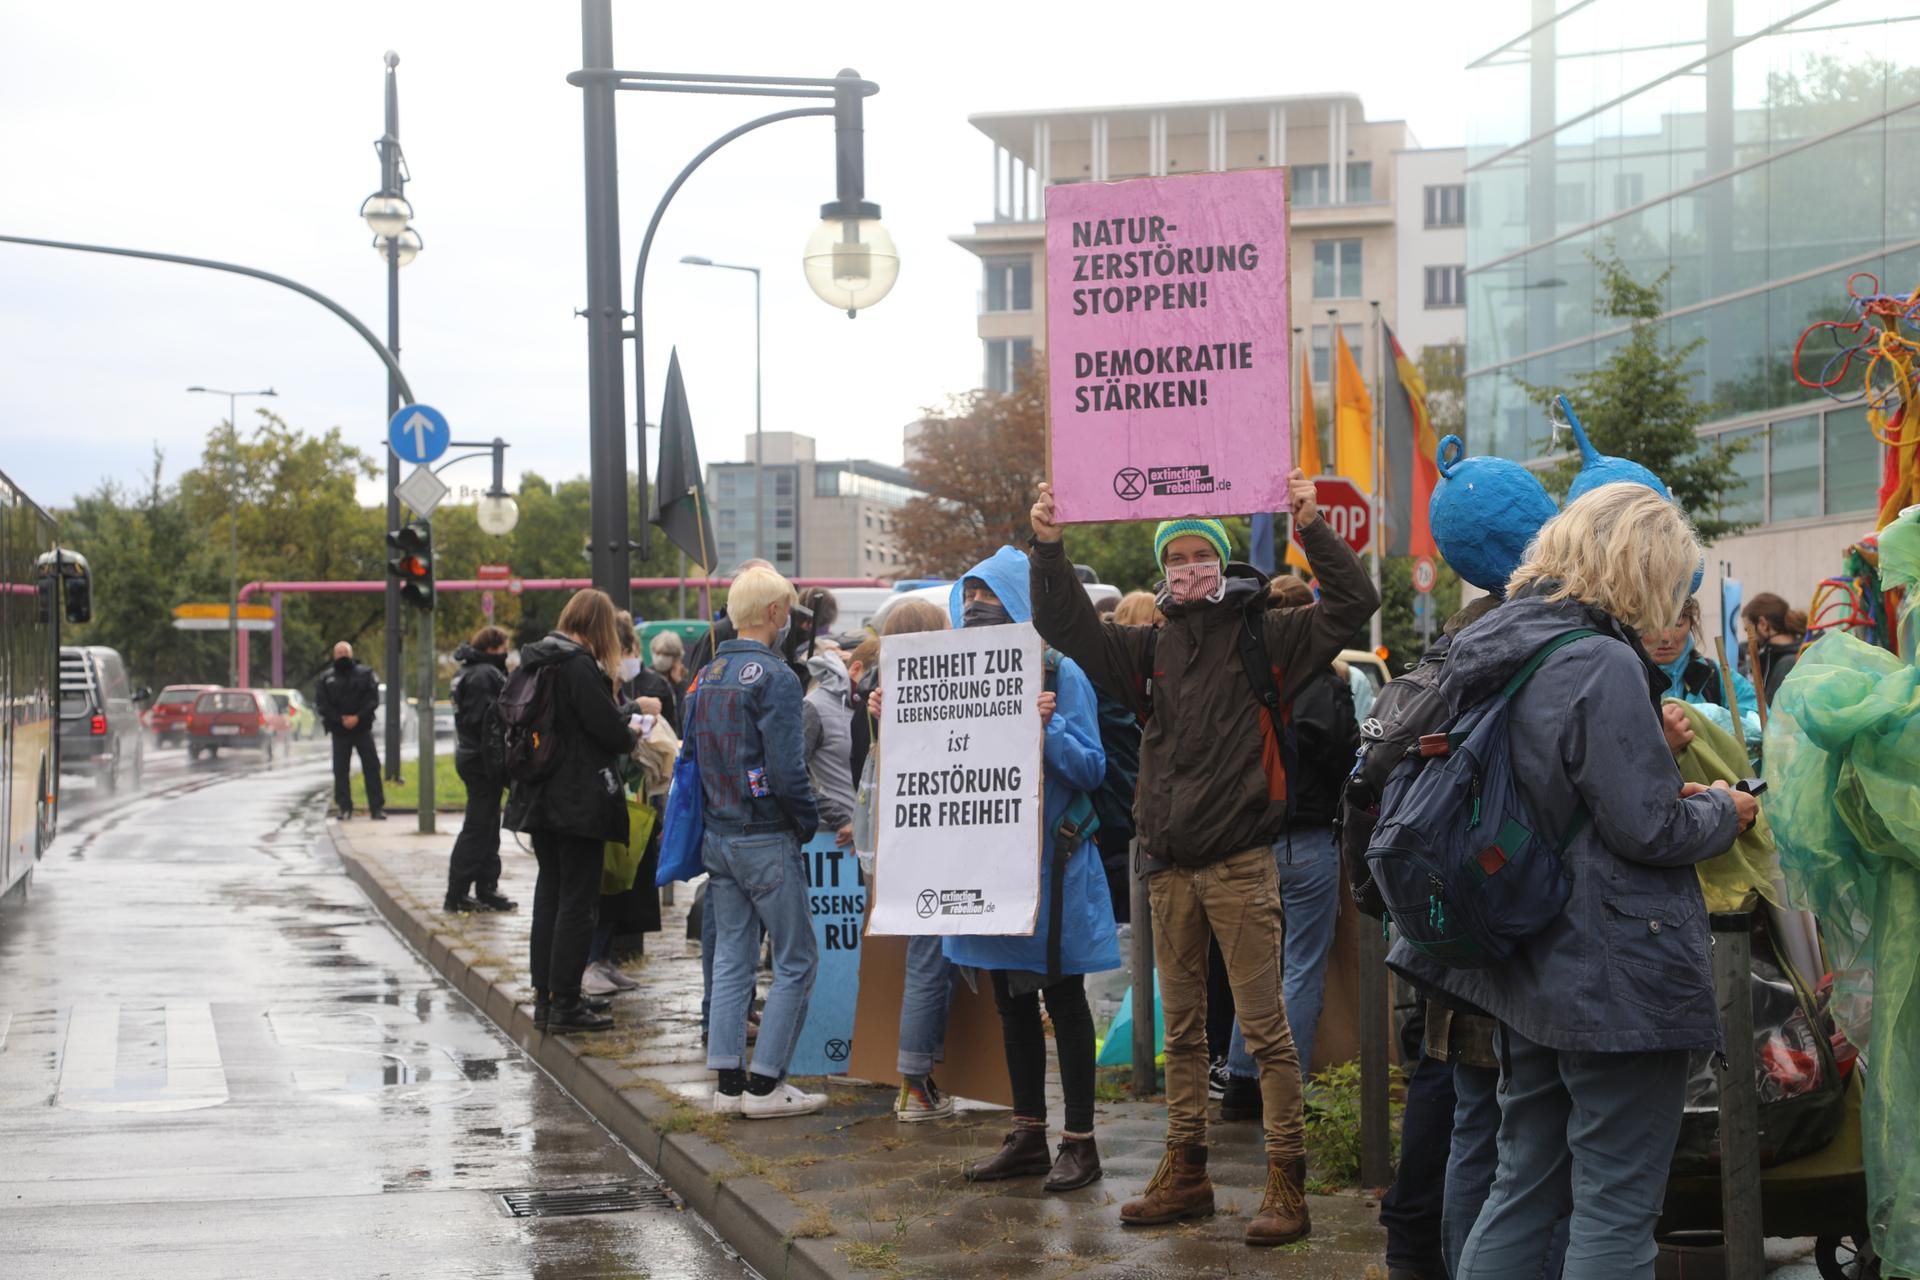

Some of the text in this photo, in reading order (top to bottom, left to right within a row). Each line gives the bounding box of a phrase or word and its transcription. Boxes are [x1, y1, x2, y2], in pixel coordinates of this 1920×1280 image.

[1072, 215, 1178, 248] NATUR-
[1072, 243, 1259, 282] ZERSTÖRUNG
[1072, 281, 1208, 316] STOPPEN!
[1075, 342, 1253, 379] DEMOKRATIE
[1075, 377, 1208, 413] STÄRKEN!
[1150, 467, 1201, 481] extinction
[1165, 480, 1213, 494] rebellion
[1315, 504, 1367, 542] TOP
[897, 648, 1023, 682] FREIHEIT ZUR
[897, 677, 1024, 705] ZERSTÖRUNG DER
[897, 699, 1022, 724] LEBENSGRUNDLAGEN
[947, 729, 970, 753] ist
[896, 764, 1022, 797] ZERSTÖRUNG
[895, 798, 1022, 828] DER FREIHEIT
[810, 895, 865, 915] SSENS
[824, 917, 862, 950] RÜ
